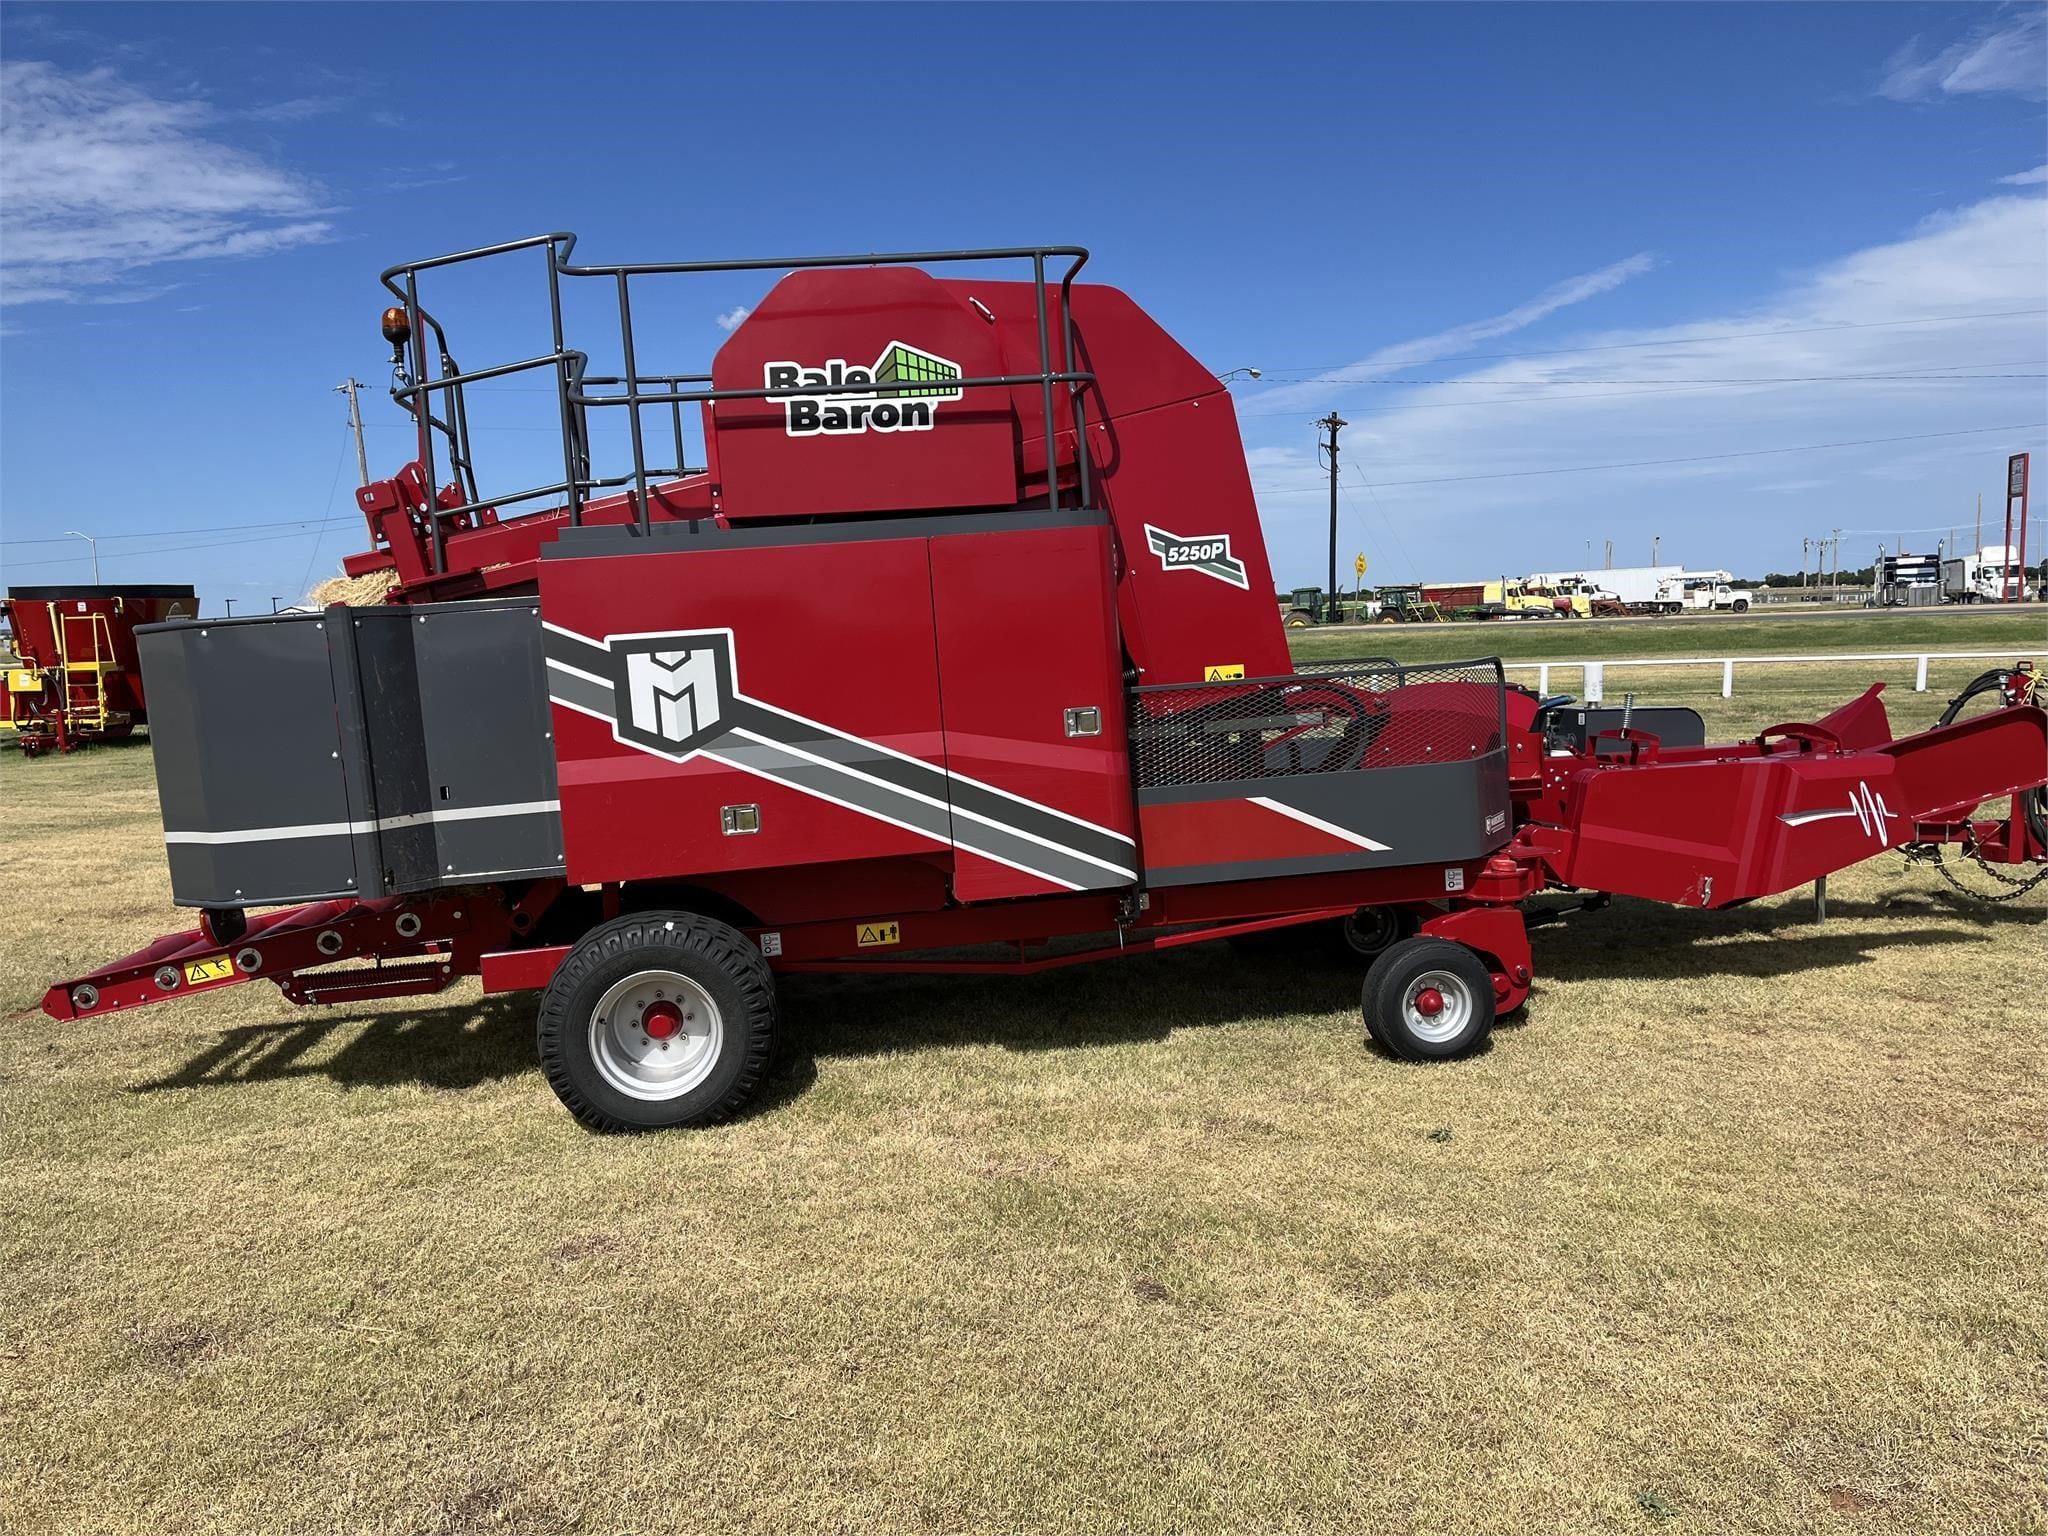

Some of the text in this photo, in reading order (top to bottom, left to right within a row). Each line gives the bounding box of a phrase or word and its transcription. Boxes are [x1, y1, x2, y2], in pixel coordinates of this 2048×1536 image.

[770, 363, 870, 394] Bale
[791, 400, 929, 431] Baron
[1167, 543, 1225, 562] 5250P
